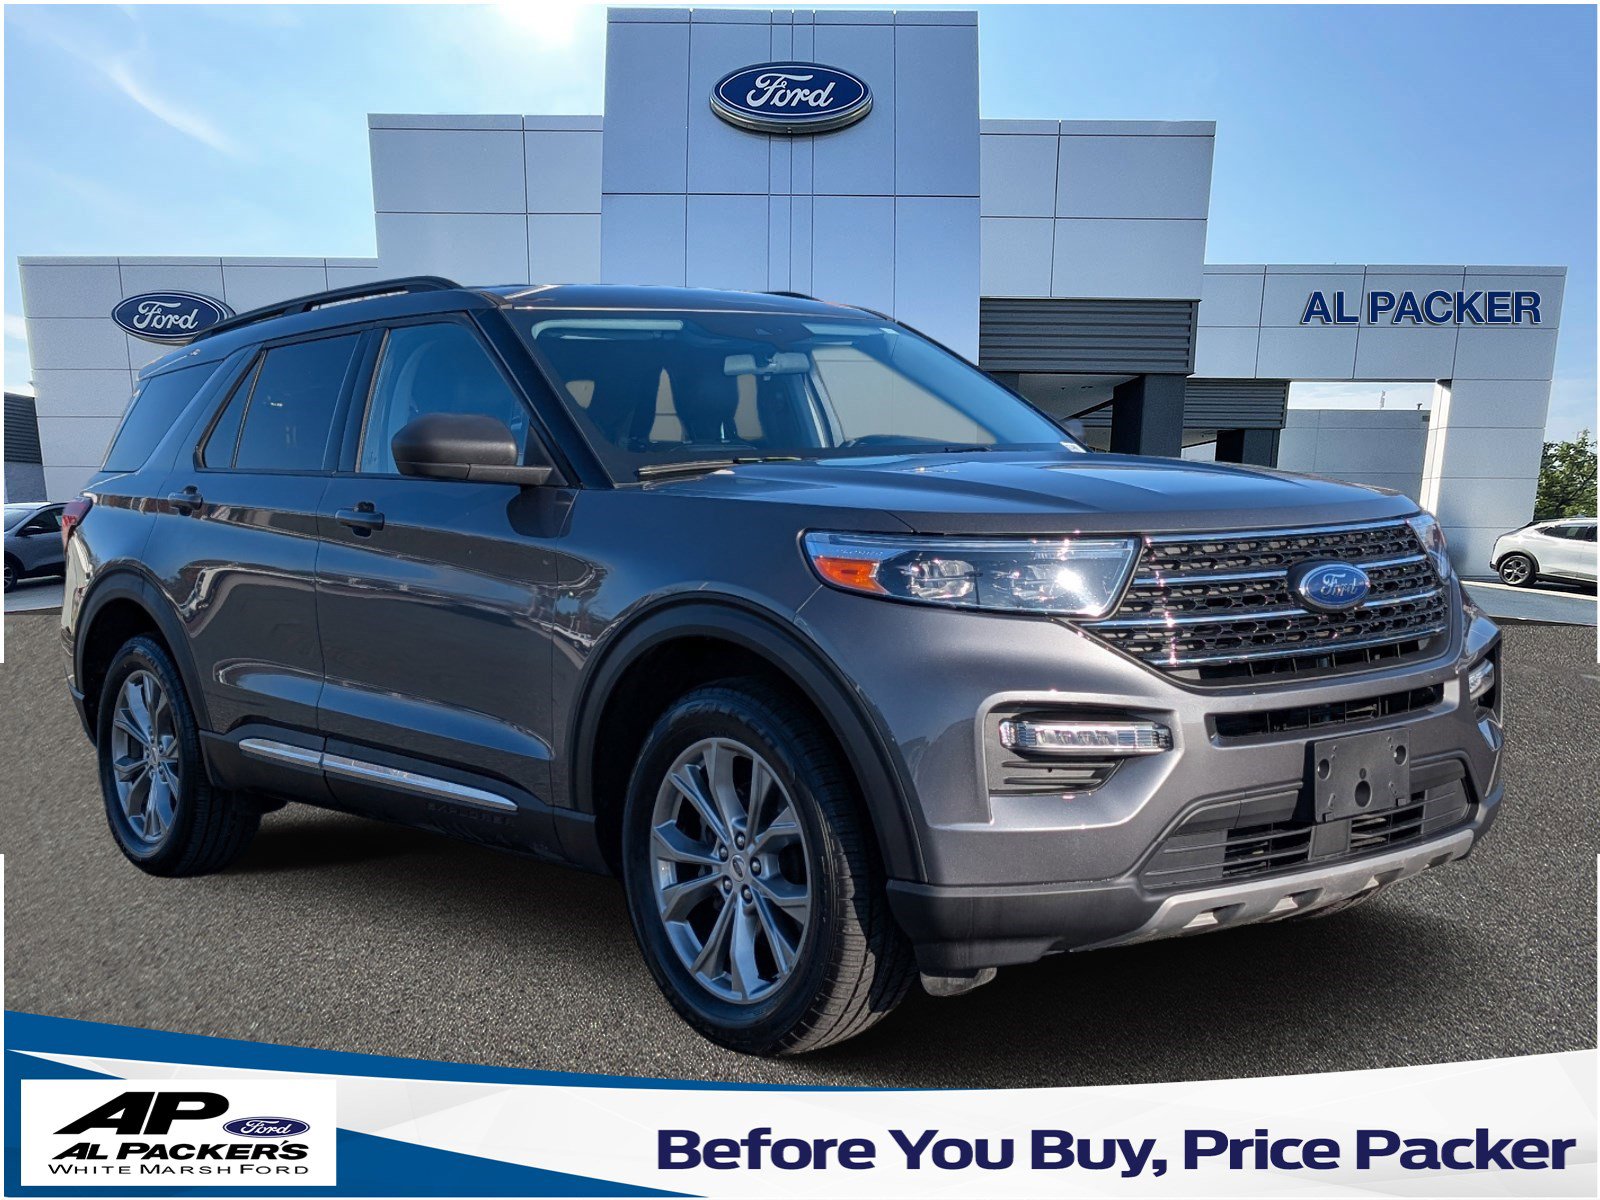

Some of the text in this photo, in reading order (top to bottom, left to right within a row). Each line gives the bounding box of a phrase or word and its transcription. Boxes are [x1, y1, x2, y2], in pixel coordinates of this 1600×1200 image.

[746, 73, 835, 108] Ford
[133, 301, 199, 329] Ford
[1302, 290, 1542, 325] AL PACKER
[1320, 573, 1358, 596] Ford
